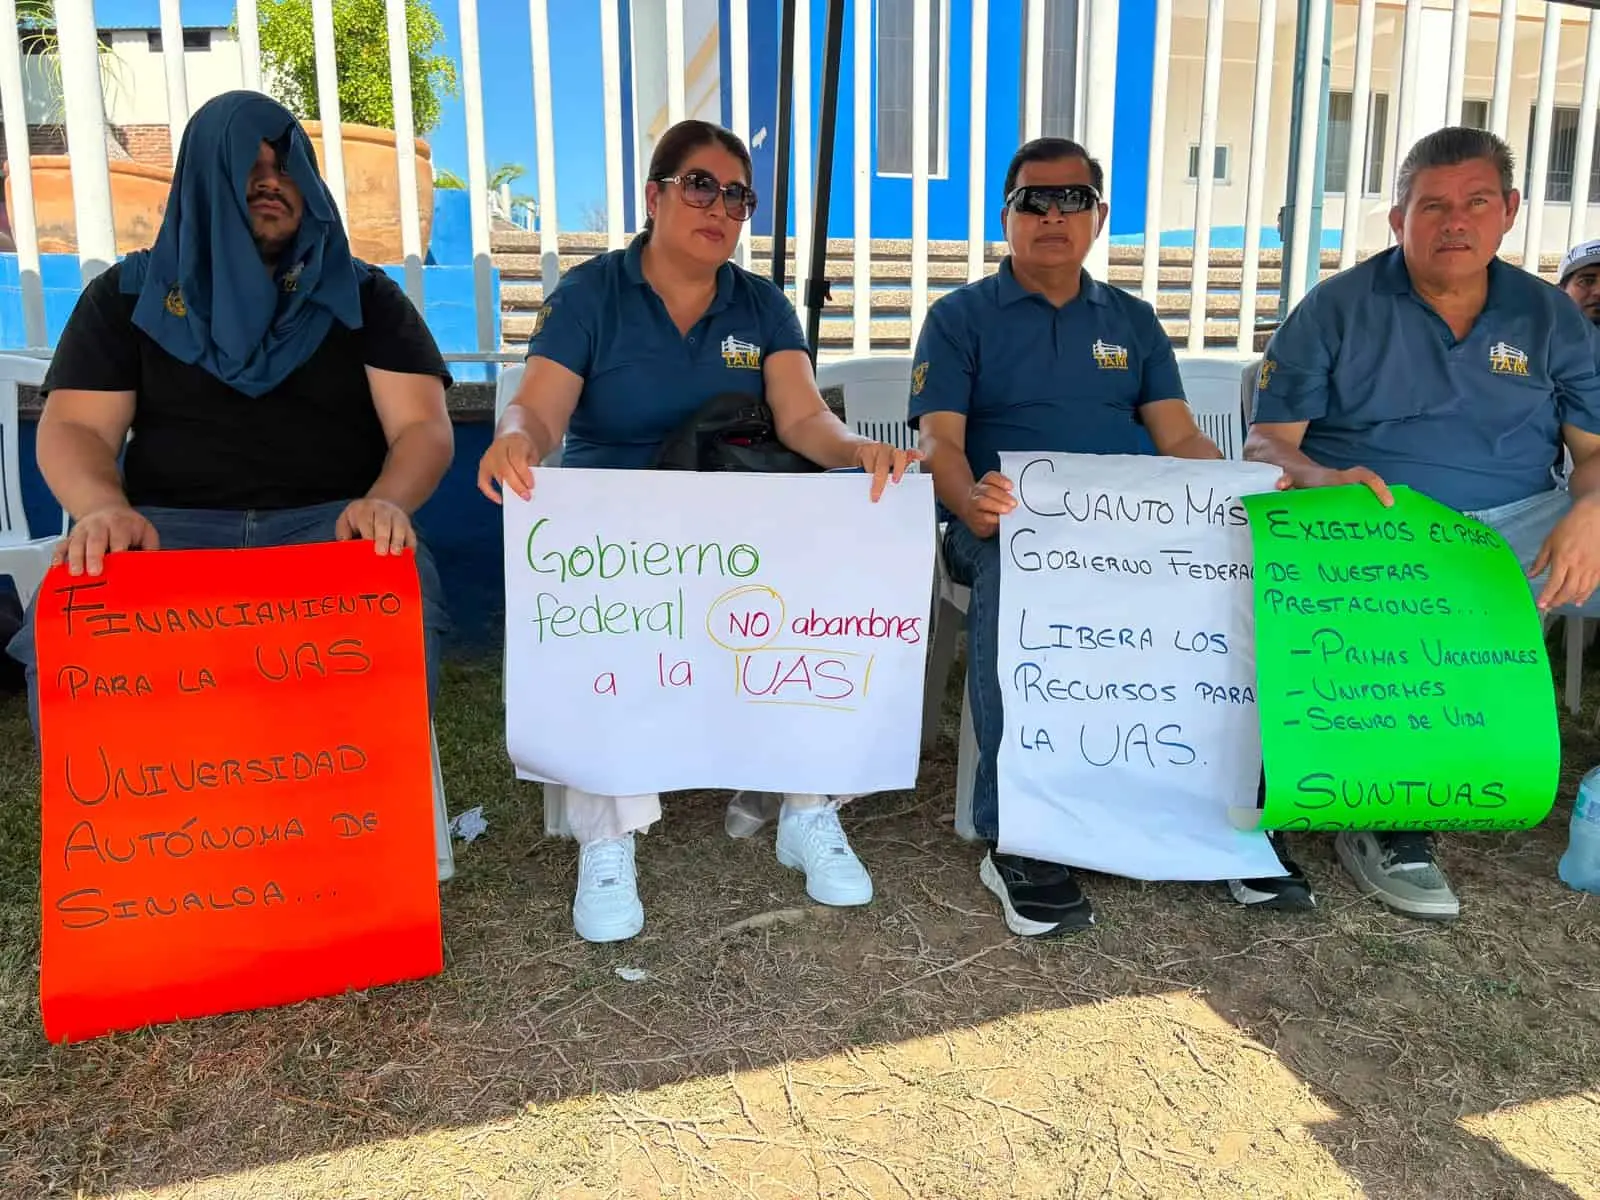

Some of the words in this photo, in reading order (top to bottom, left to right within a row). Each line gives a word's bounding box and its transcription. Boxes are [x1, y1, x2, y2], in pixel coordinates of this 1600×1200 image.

[721, 351, 760, 367] TAM
[1094, 352, 1128, 368] TAM
[1490, 355, 1528, 373] TAM
[1019, 458, 1174, 524] CUANTO
[1185, 484, 1249, 526] MÁS
[1266, 509, 1415, 544] EXIGIMOS
[1429, 523, 1454, 543] EL
[527, 518, 760, 582] Gobierno
[1010, 528, 1153, 575] GOBIERNO
[1265, 562, 1301, 582] DE
[1318, 563, 1430, 584] NUESTRAS
[55, 581, 401, 636] FINANCIAMIENTO
[532, 588, 684, 643] federal
[729, 611, 770, 638] NO
[792, 608, 921, 644] abandones
[1019, 608, 1153, 651] LIBERA
[1174, 630, 1228, 654] LOS
[57, 665, 153, 699] PARA
[178, 668, 216, 692] LA
[255, 640, 371, 681] UAS
[1420, 638, 1538, 668] VACACIONALES
[593, 672, 617, 696] a
[659, 652, 693, 687] la
[743, 655, 854, 700] UAS
[1014, 662, 1177, 703] RECURSOS
[1195, 682, 1256, 704] PARA
[1408, 713, 1433, 730] DE
[1442, 706, 1486, 729] VIDA
[1020, 725, 1055, 753] LA
[1079, 723, 1208, 768] UAS.
[65, 745, 367, 806] UNIVERSIDAD
[1293, 772, 1509, 810] SUNTUAS
[65, 817, 305, 871] AUTÓNOMA
[332, 812, 378, 838] DE
